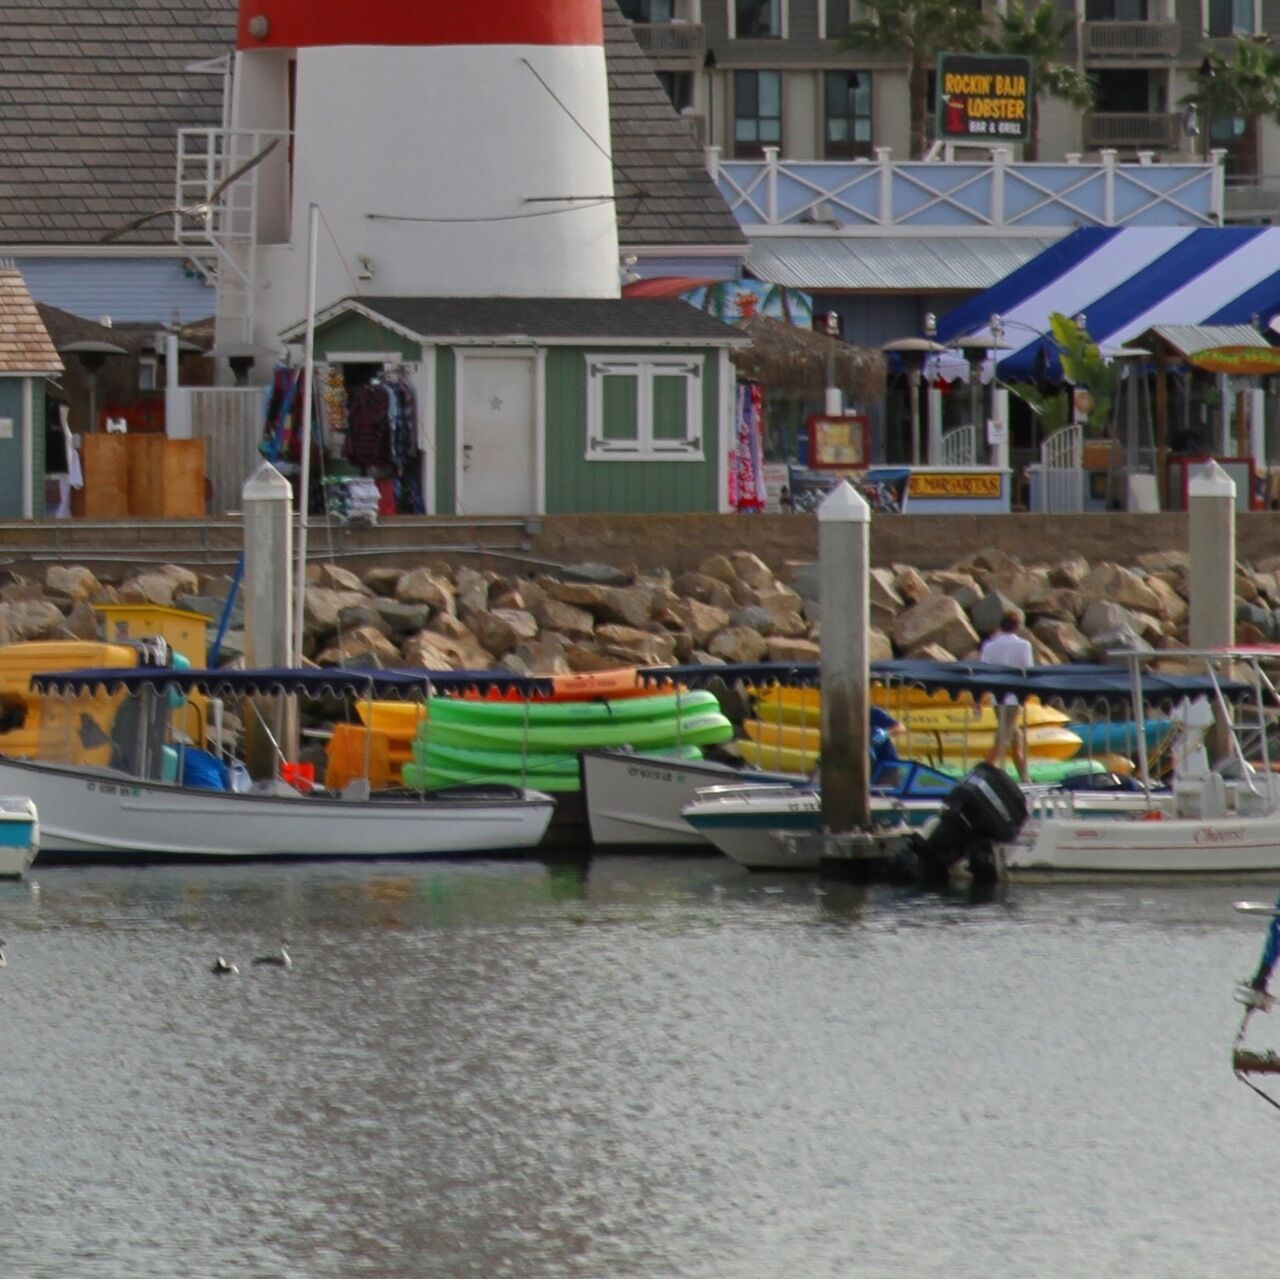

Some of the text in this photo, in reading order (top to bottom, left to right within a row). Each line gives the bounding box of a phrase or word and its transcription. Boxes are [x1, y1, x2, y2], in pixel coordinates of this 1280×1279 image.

[944, 73, 1026, 96] ROCKIN' BAJA
[967, 98, 1024, 119] LOBSTER
[968, 121, 987, 133] BAR
[998, 122, 1022, 134] GRILL
